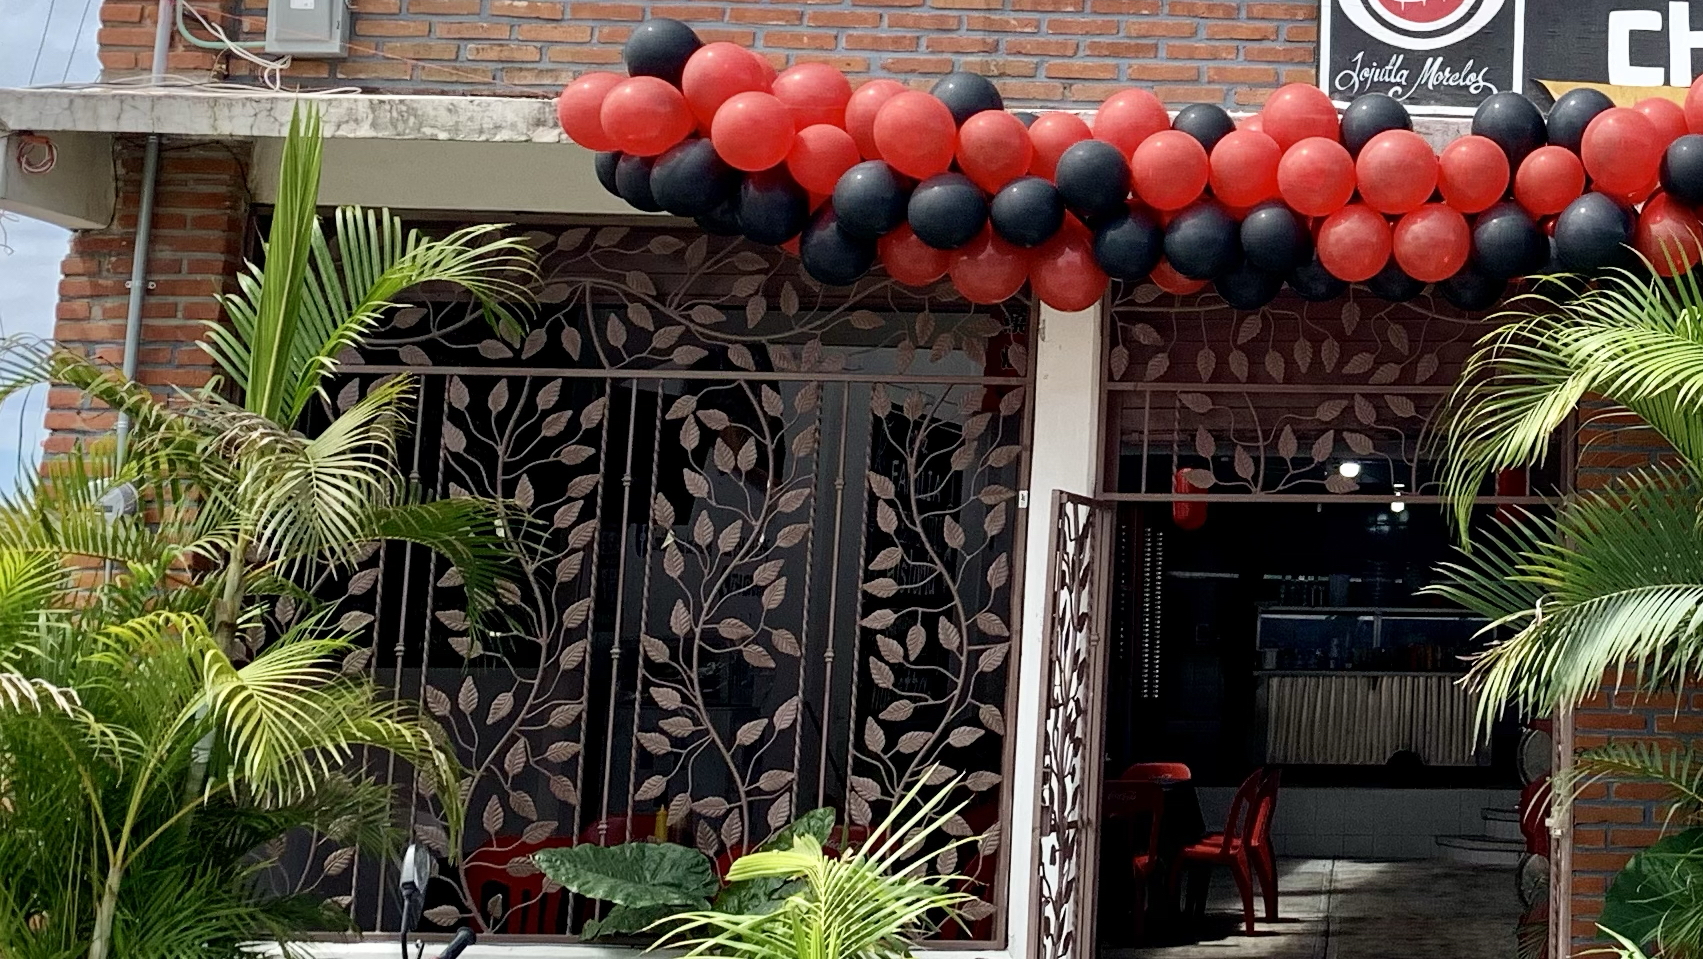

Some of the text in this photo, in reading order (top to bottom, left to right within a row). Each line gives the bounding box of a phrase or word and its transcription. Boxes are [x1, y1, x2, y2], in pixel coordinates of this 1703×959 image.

[1335, 51, 1498, 101] Jojutla Morelos
[890, 459, 941, 503] FAILIA
